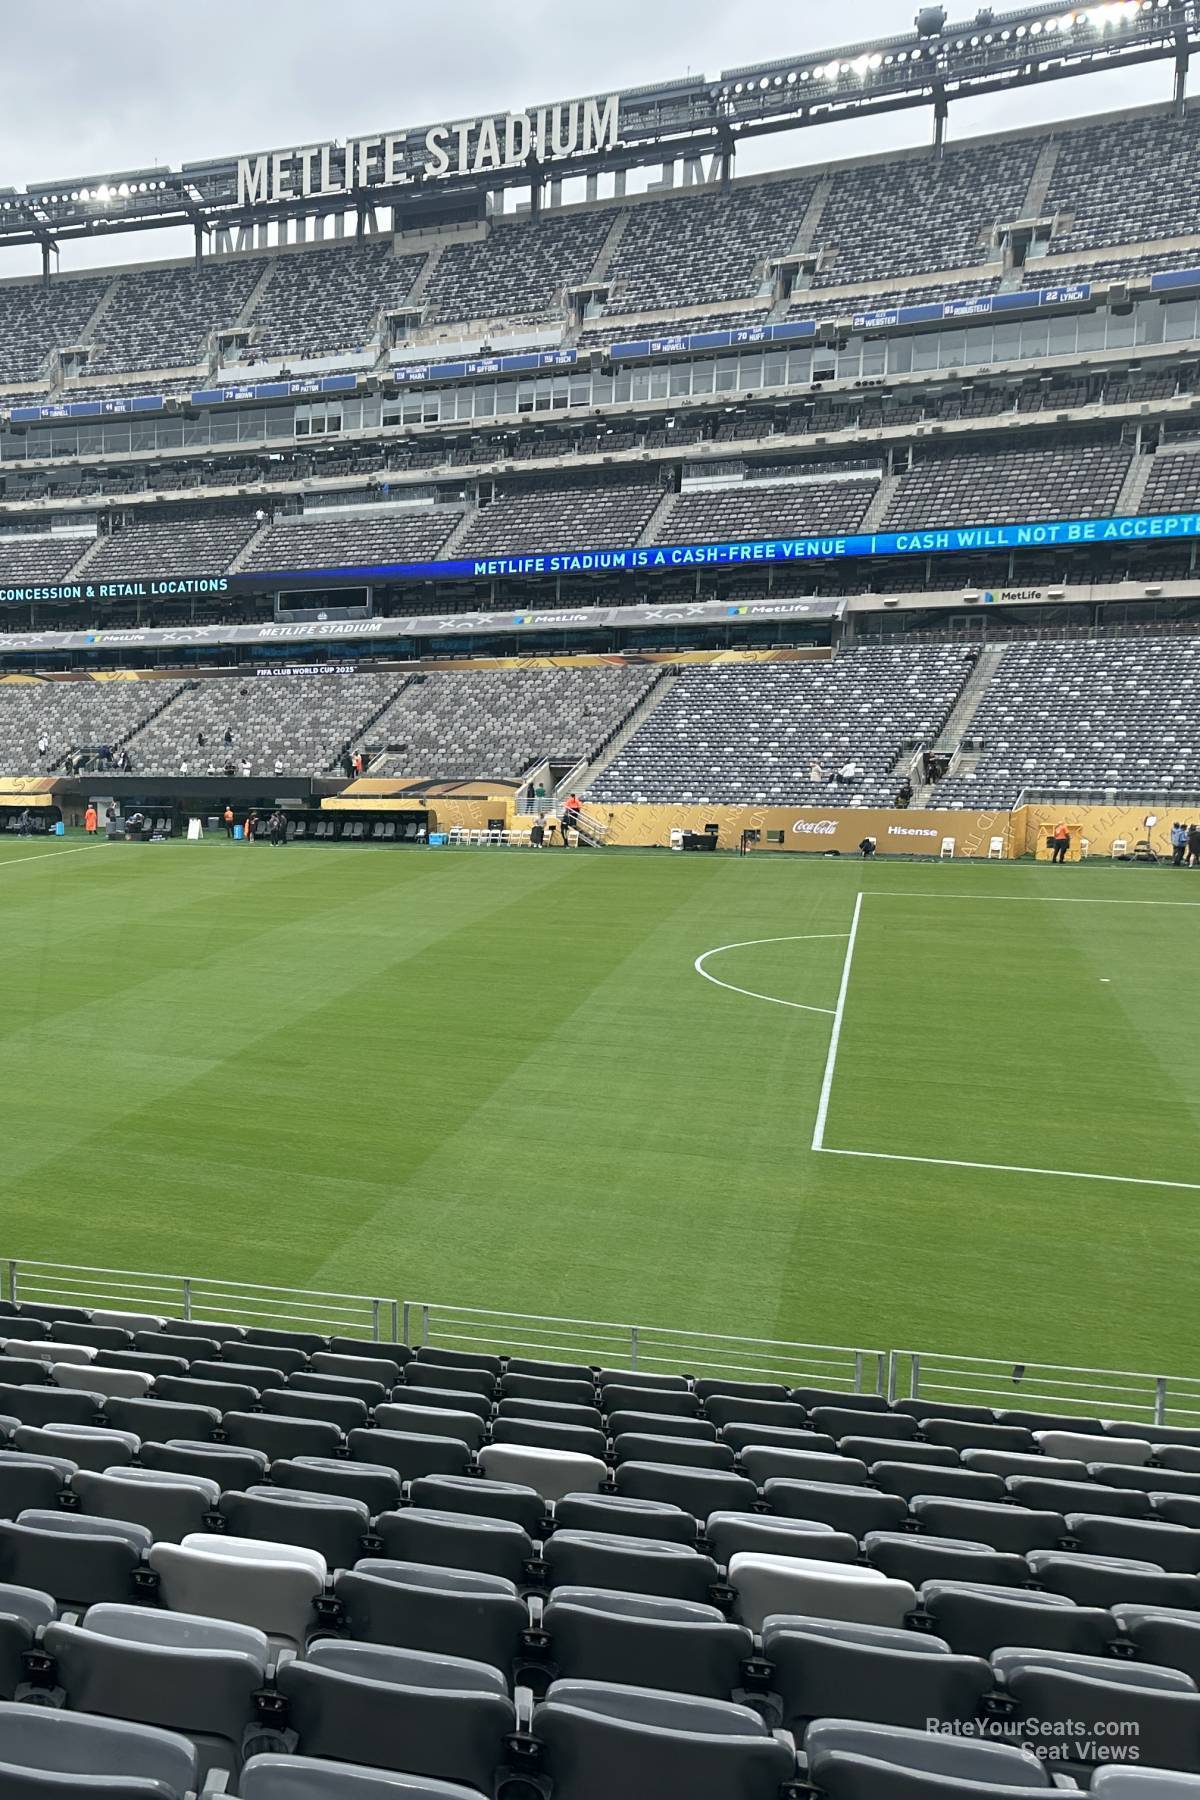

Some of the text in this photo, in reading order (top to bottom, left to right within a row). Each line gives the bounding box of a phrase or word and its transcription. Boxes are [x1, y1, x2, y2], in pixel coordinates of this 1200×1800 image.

[237, 134, 407, 205] METLIFE
[425, 96, 620, 176] STADIUM
[1045, 292, 1083, 302] 22 LYNCH
[854, 317, 896, 327] 29 WEBSTER
[737, 332, 765, 341] 70 HUFF
[662, 343, 686, 352] HOWELL
[555, 355, 571, 364] TISCH
[474, 558, 545, 575] METLIFE
[550, 554, 626, 571] STADIUM
[632, 552, 648, 565] IS
[654, 551, 666, 564] A
[671, 544, 776, 563] CASH-FREE
[782, 540, 846, 557] VENUE
[896, 533, 949, 551] CASH
[957, 530, 1009, 547] WILL
[1017, 526, 1060, 543] NOT
[1067, 523, 1096, 540] BE
[86, 586, 95, 598] &
[100, 583, 146, 597] RETAIL
[151, 579, 228, 594] LOCATIONS
[1001, 591, 1042, 600] MetLife
[751, 604, 810, 614] MetLife
[534, 614, 588, 623] MetLife
[258, 623, 382, 637] METLIFE STADIUM
[292, 667, 319, 675] WORLD
[887, 826, 938, 836] Hisense
